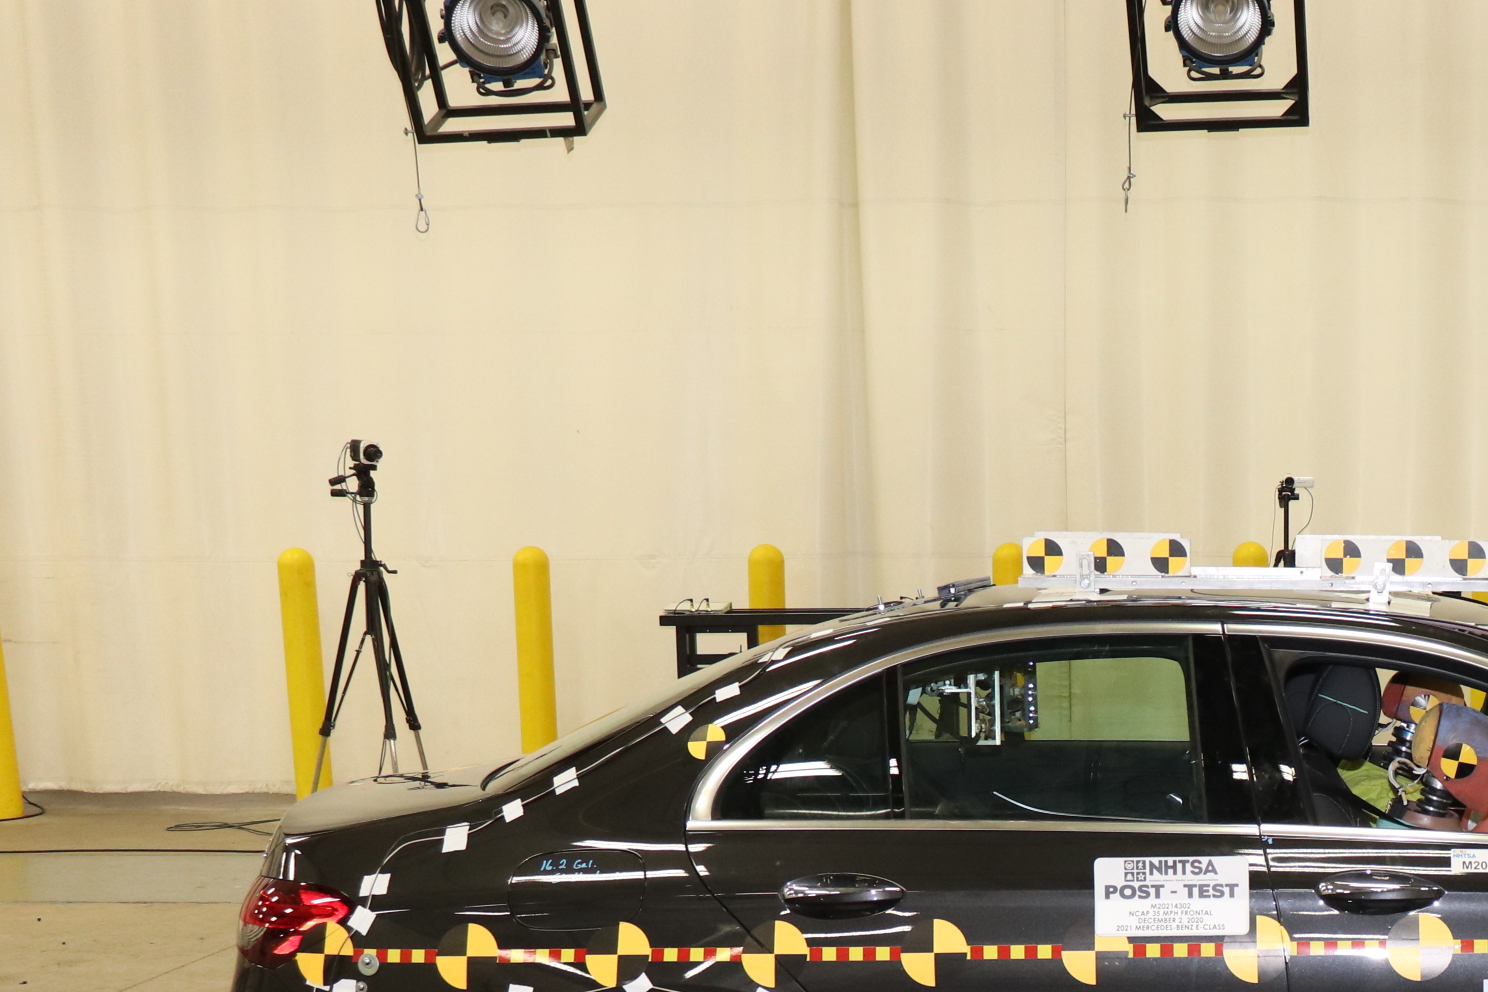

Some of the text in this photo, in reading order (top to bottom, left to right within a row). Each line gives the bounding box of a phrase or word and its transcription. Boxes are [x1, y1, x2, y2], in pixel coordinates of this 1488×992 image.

[540, 859, 567, 871] 16.2
[1149, 859, 1218, 876] NHTSA
[1104, 884, 1165, 900] POST
[1183, 884, 1239, 899] TEST
[1181, 909, 1213, 917] FRONTAL
[1179, 917, 1185, 925] 2,
[1116, 924, 1133, 932] 2021
[1196, 923, 1226, 931] E-CLASS
